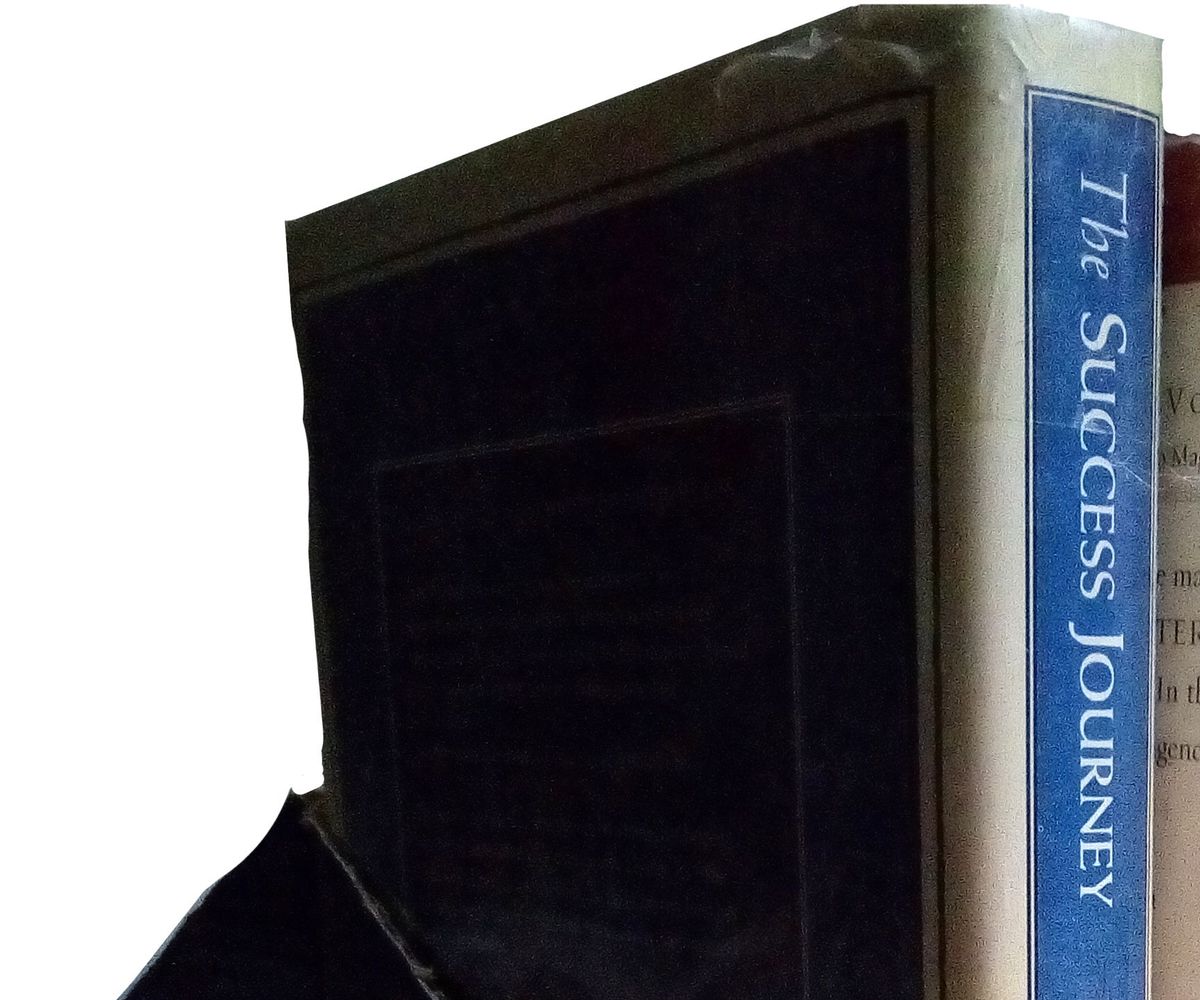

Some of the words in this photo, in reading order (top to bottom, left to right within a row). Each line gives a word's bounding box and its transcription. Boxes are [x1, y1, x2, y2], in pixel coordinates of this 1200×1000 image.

[1079, 172, 1128, 280] The
[1079, 311, 1127, 601] SUCCESS
[1069, 620, 1124, 907] JOURNEY
